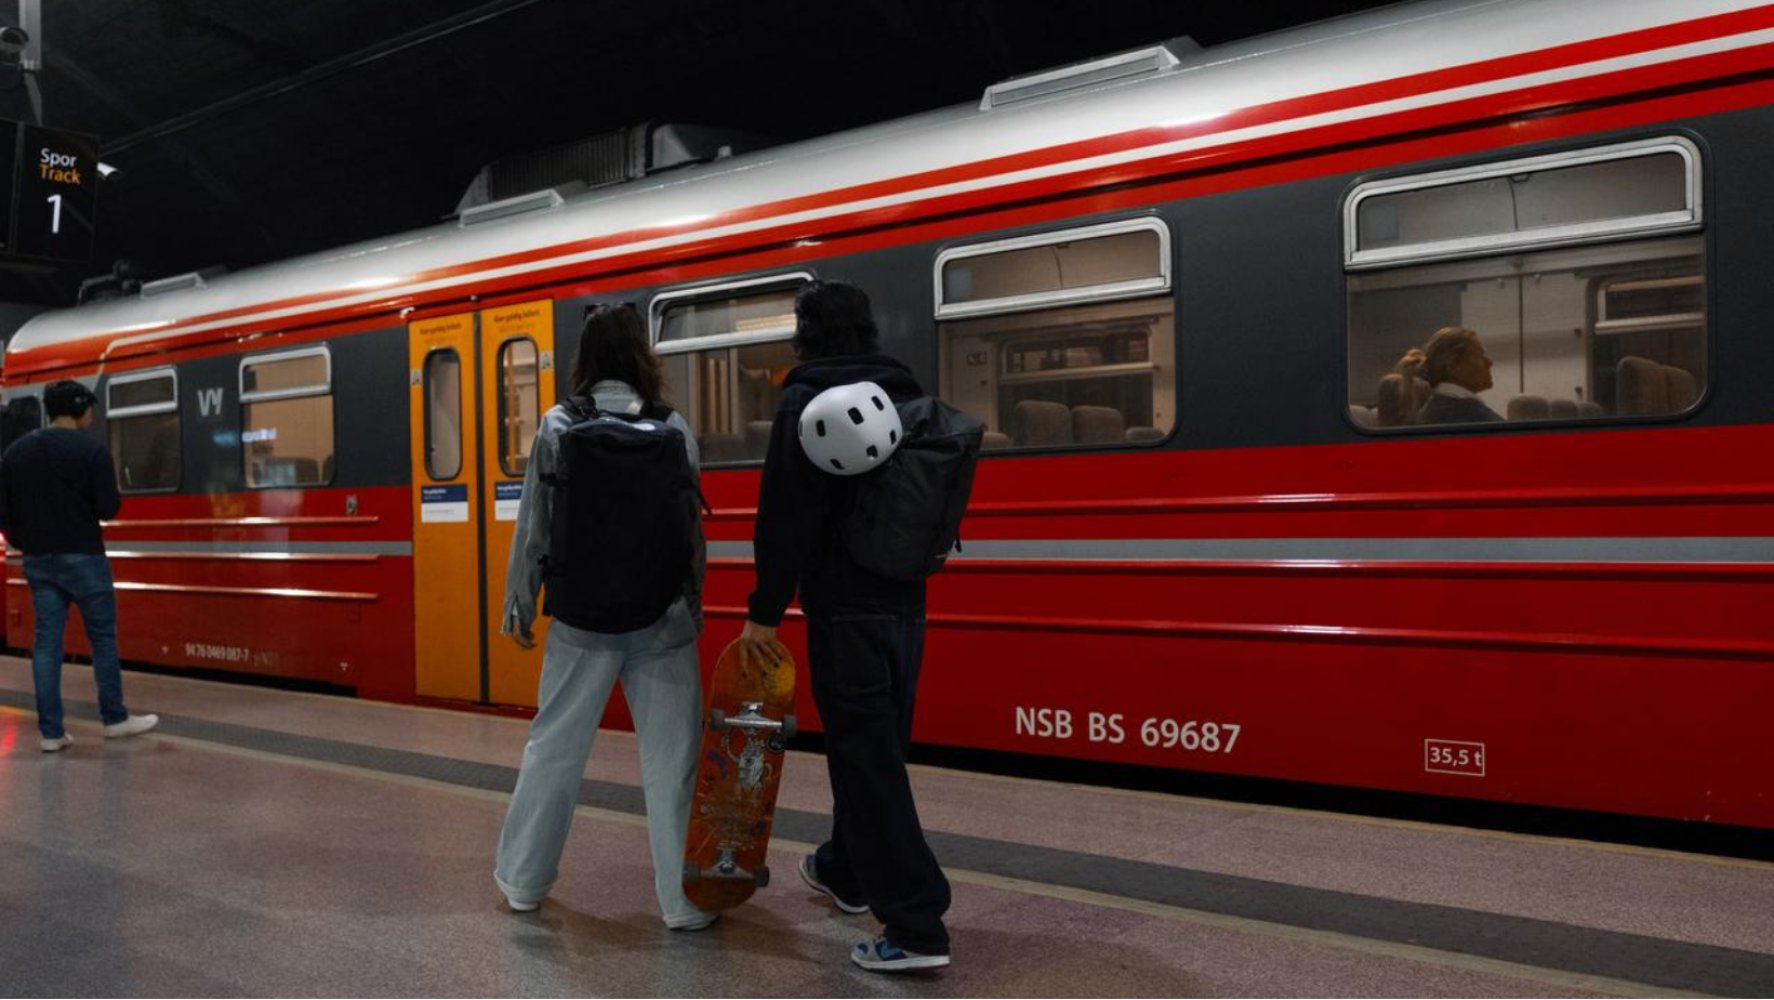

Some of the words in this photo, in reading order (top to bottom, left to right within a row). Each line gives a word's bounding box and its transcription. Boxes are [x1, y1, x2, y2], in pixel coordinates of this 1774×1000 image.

[40, 147, 77, 167] Spor
[39, 164, 81, 185] Track
[47, 194, 62, 235] 1
[1015, 705, 1073, 738] NSB
[1088, 711, 1126, 744] BS
[1140, 717, 1241, 754] 69687
[1429, 746, 1469, 767] 35,5
[1474, 751, 1483, 767] t
